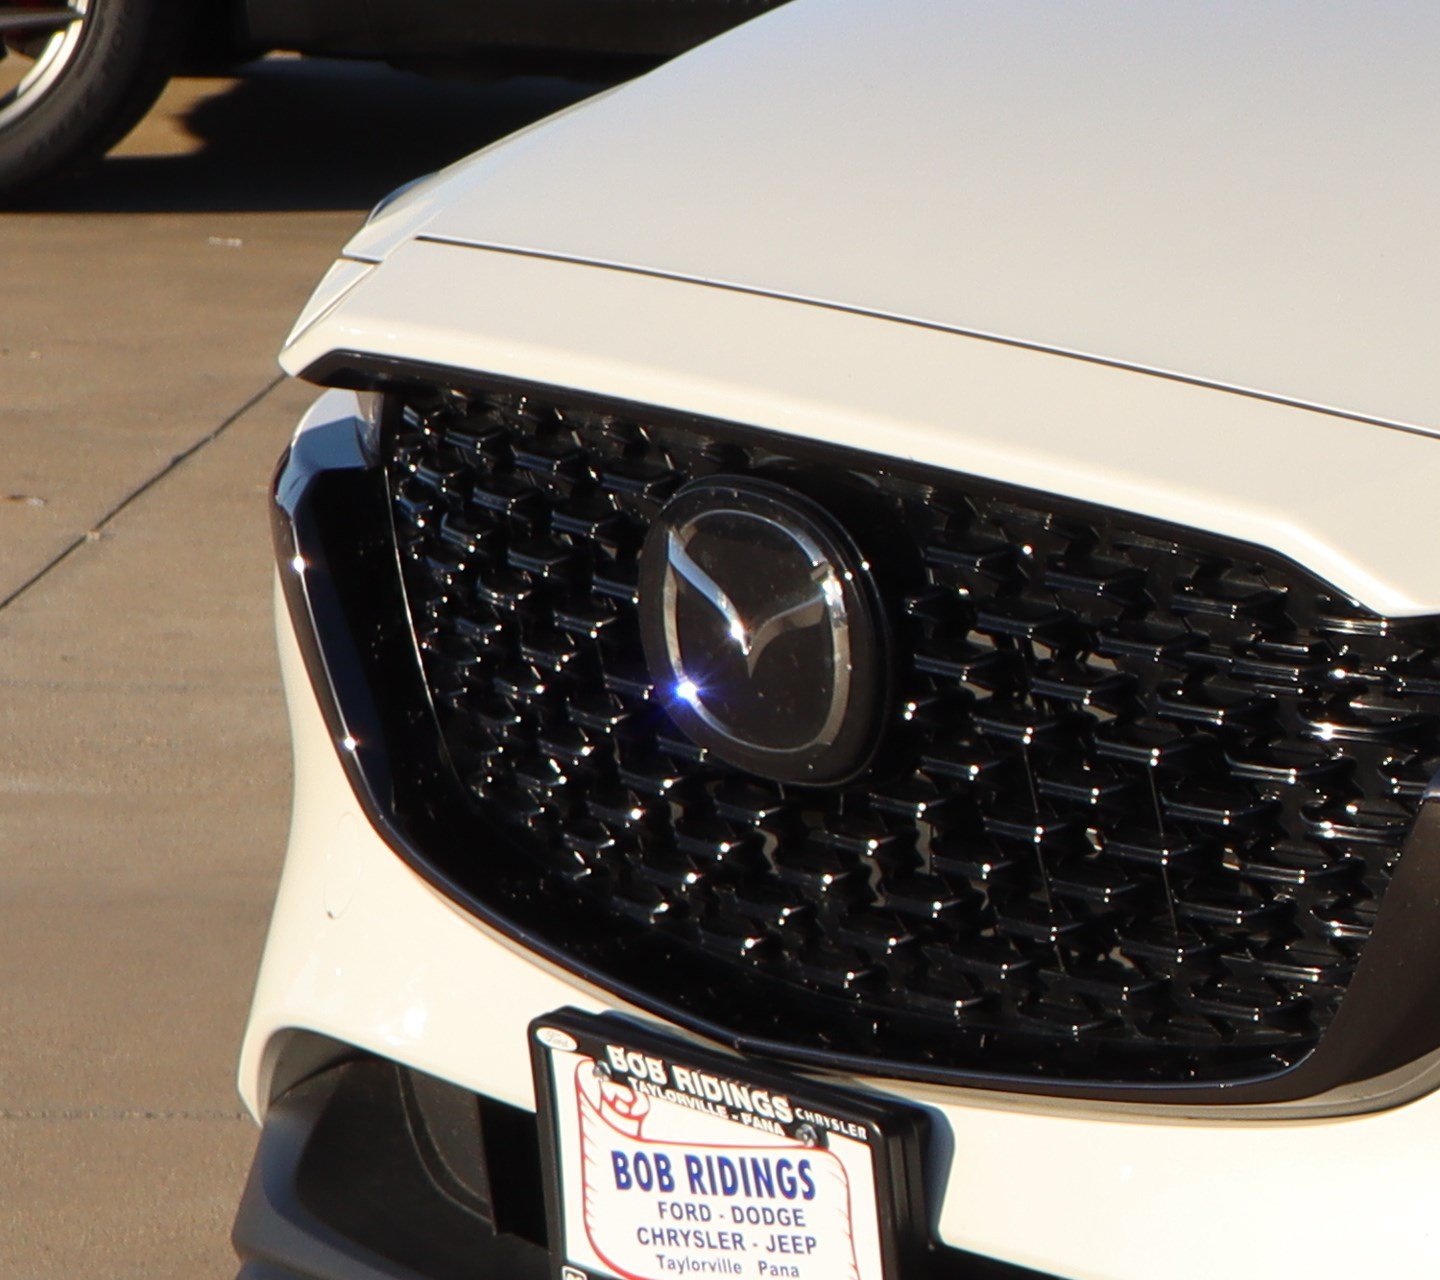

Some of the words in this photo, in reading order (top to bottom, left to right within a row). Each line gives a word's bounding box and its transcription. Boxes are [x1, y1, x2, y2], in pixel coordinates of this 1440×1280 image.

[606, 1044, 667, 1086] BOB
[672, 1064, 794, 1123] RIDINGS
[627, 1077, 728, 1117] TAYLORVILLE
[742, 1112, 785, 1137] PANA
[795, 1107, 868, 1140] CHRYSLER
[611, 1150, 675, 1194] BOB
[685, 1154, 817, 1200] RIDINGS
[658, 1201, 711, 1222] FORD
[731, 1205, 806, 1227] DODGE
[637, 1227, 746, 1251] CHRYSLER
[765, 1234, 817, 1255] JEEP
[656, 1255, 742, 1275] Taylorville
[758, 1261, 800, 1278] Pana
